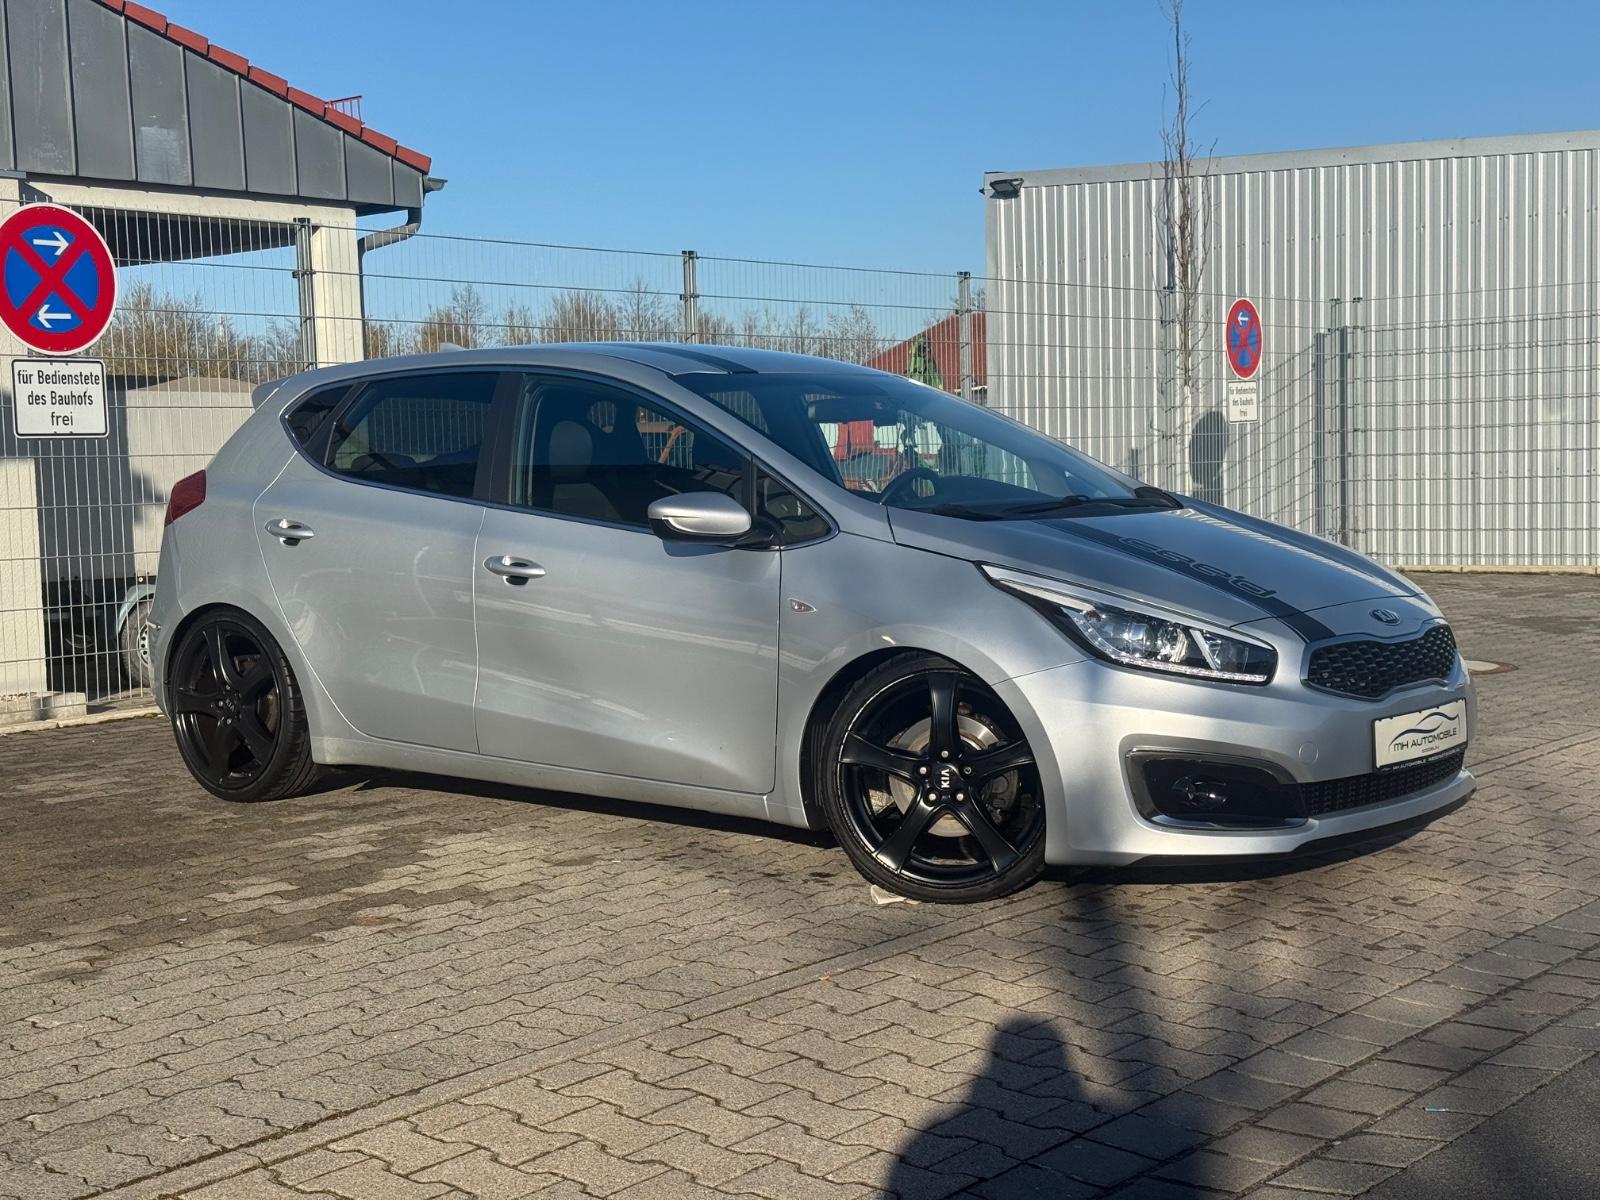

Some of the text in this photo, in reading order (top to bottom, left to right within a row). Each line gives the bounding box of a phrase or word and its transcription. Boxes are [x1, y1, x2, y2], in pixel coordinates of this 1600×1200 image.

[17, 369, 100, 385] für Bedienstete
[27, 390, 94, 406] des Bauhofs
[50, 411, 74, 426] frei
[1393, 740, 1409, 752] MH
[1410, 727, 1457, 748] AUTOMOBILE
[941, 768, 950, 788] KIA
